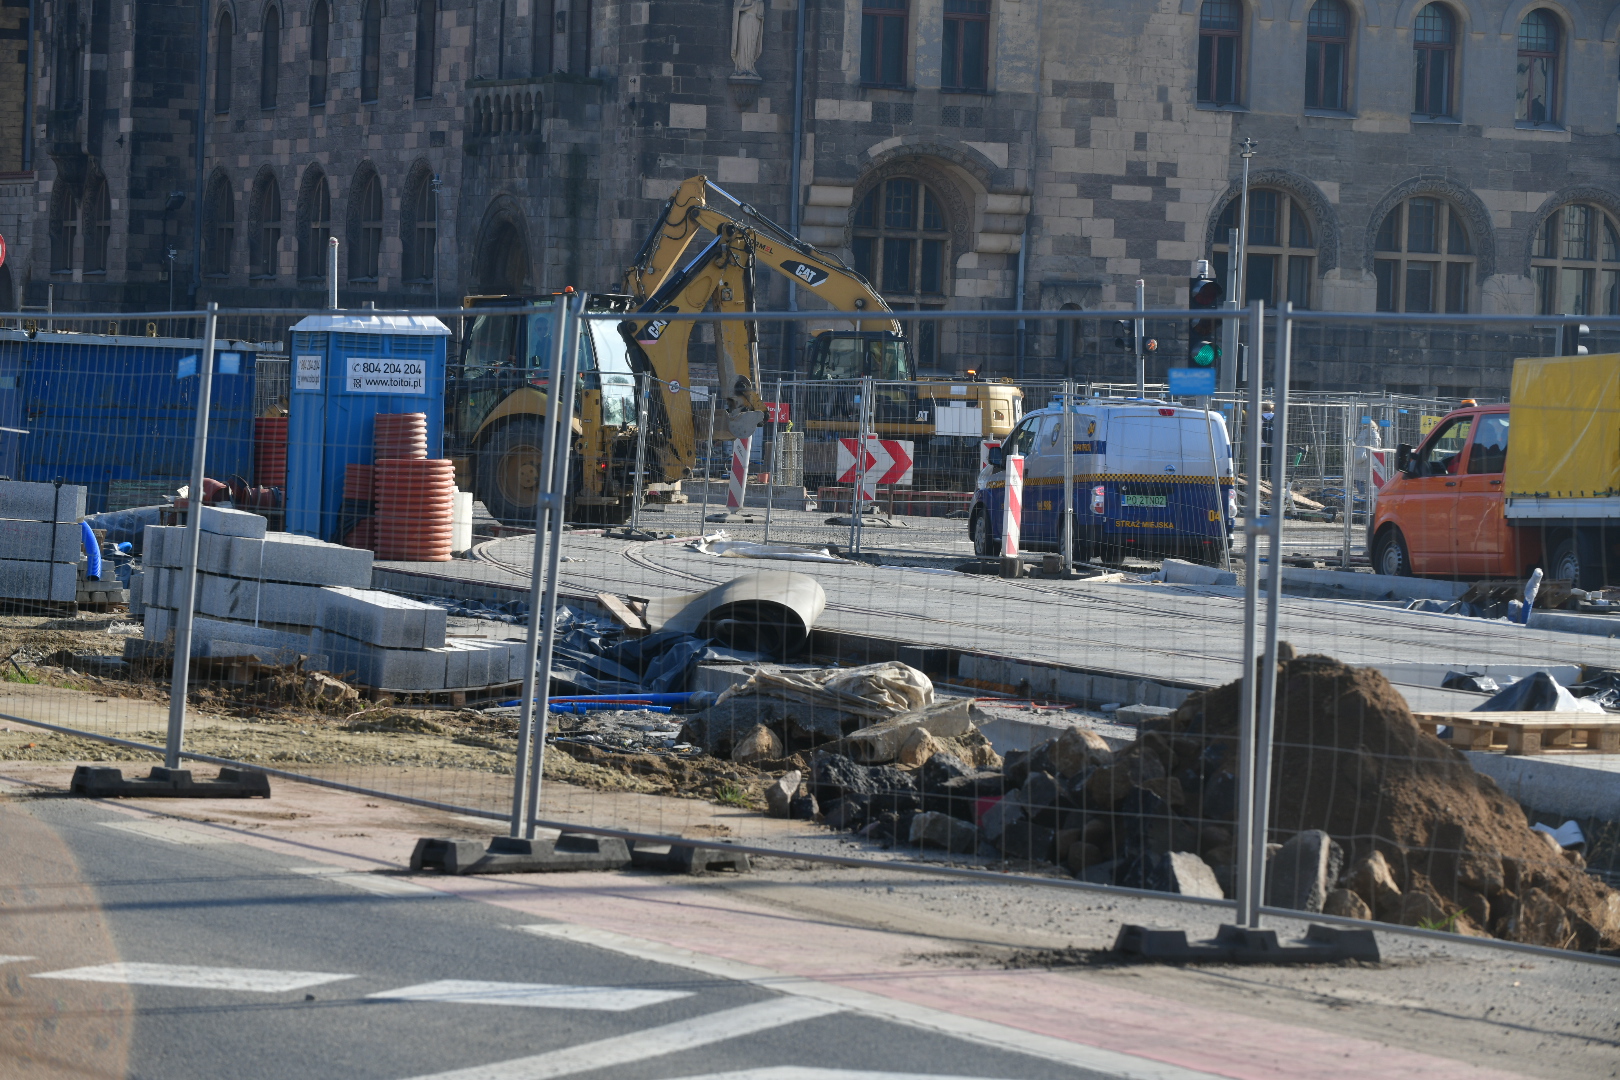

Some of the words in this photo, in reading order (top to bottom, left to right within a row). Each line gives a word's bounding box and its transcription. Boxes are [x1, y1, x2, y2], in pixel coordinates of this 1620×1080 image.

[795, 264, 816, 282] CAT
[362, 362, 381, 373] 804
[383, 363, 401, 374] 204
[403, 364, 421, 375] 204
[365, 378, 421, 389] www.toitoi.pl
[916, 410, 929, 421] AT
[1115, 519, 1140, 528] STRAŻ
[1141, 521, 1175, 529] MIEJSKA
